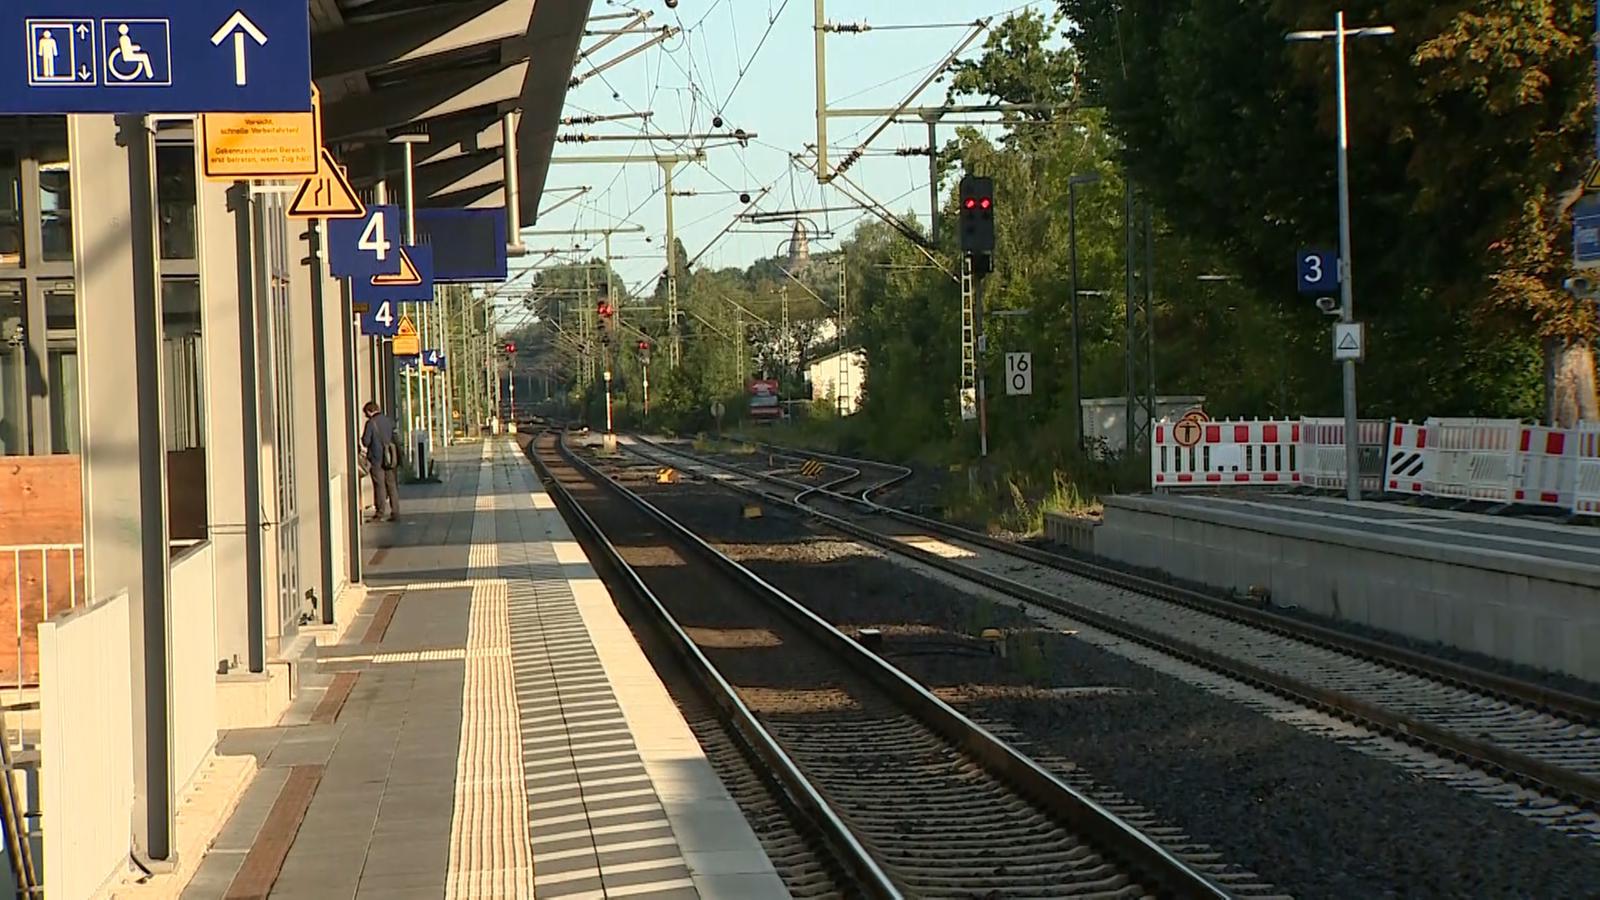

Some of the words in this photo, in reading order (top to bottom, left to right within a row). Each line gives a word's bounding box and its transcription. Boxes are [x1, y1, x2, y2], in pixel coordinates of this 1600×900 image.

[358, 211, 391, 260] 4
[1304, 255, 1322, 282] 3
[375, 301, 393, 327] 4
[429, 351, 437, 363] 4
[1008, 355, 1028, 371] 16
[1013, 374, 1025, 390] 0
